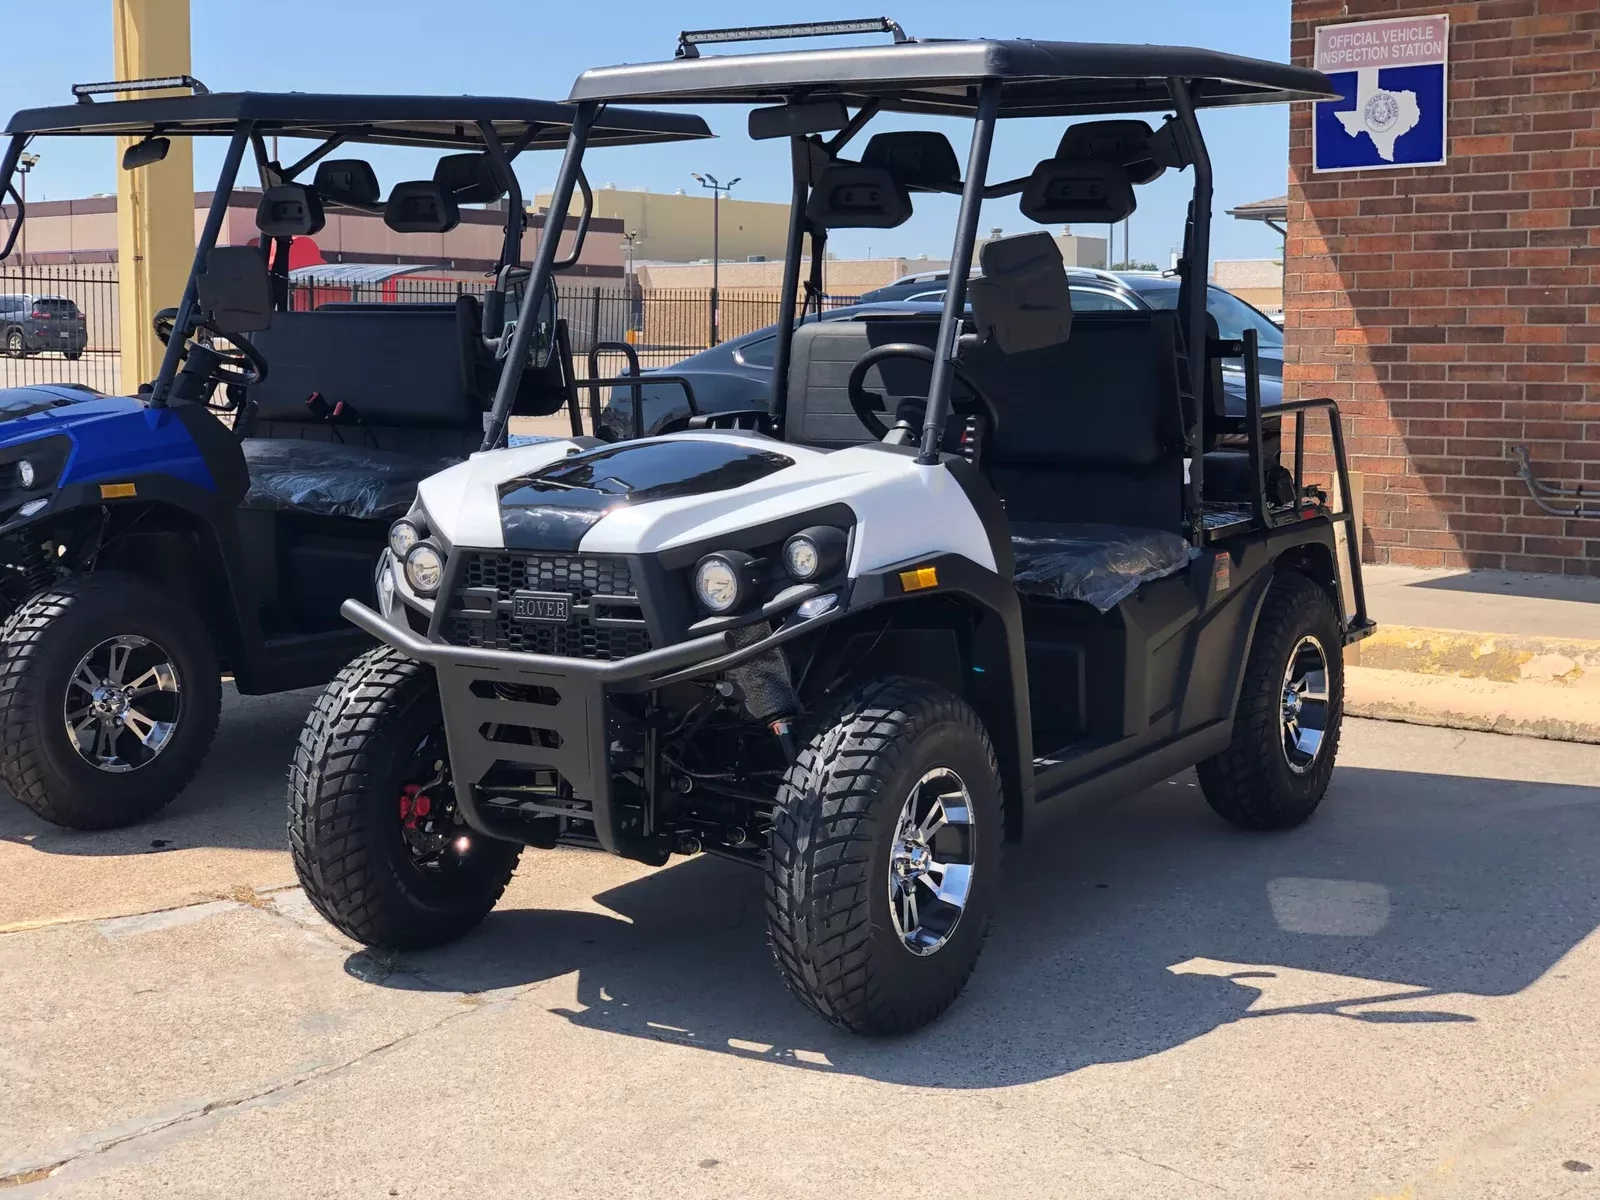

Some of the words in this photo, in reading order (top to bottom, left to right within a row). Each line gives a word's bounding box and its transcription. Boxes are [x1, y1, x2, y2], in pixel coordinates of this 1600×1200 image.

[1328, 33, 1380, 49] OFFICIAL
[1382, 26, 1434, 43] VEHICLE
[1320, 46, 1388, 64] INSPECTION
[1391, 40, 1442, 58] STATION
[1368, 95, 1382, 108] STATE
[1390, 98, 1399, 118] TEXAS
[516, 600, 565, 617] ROVER
